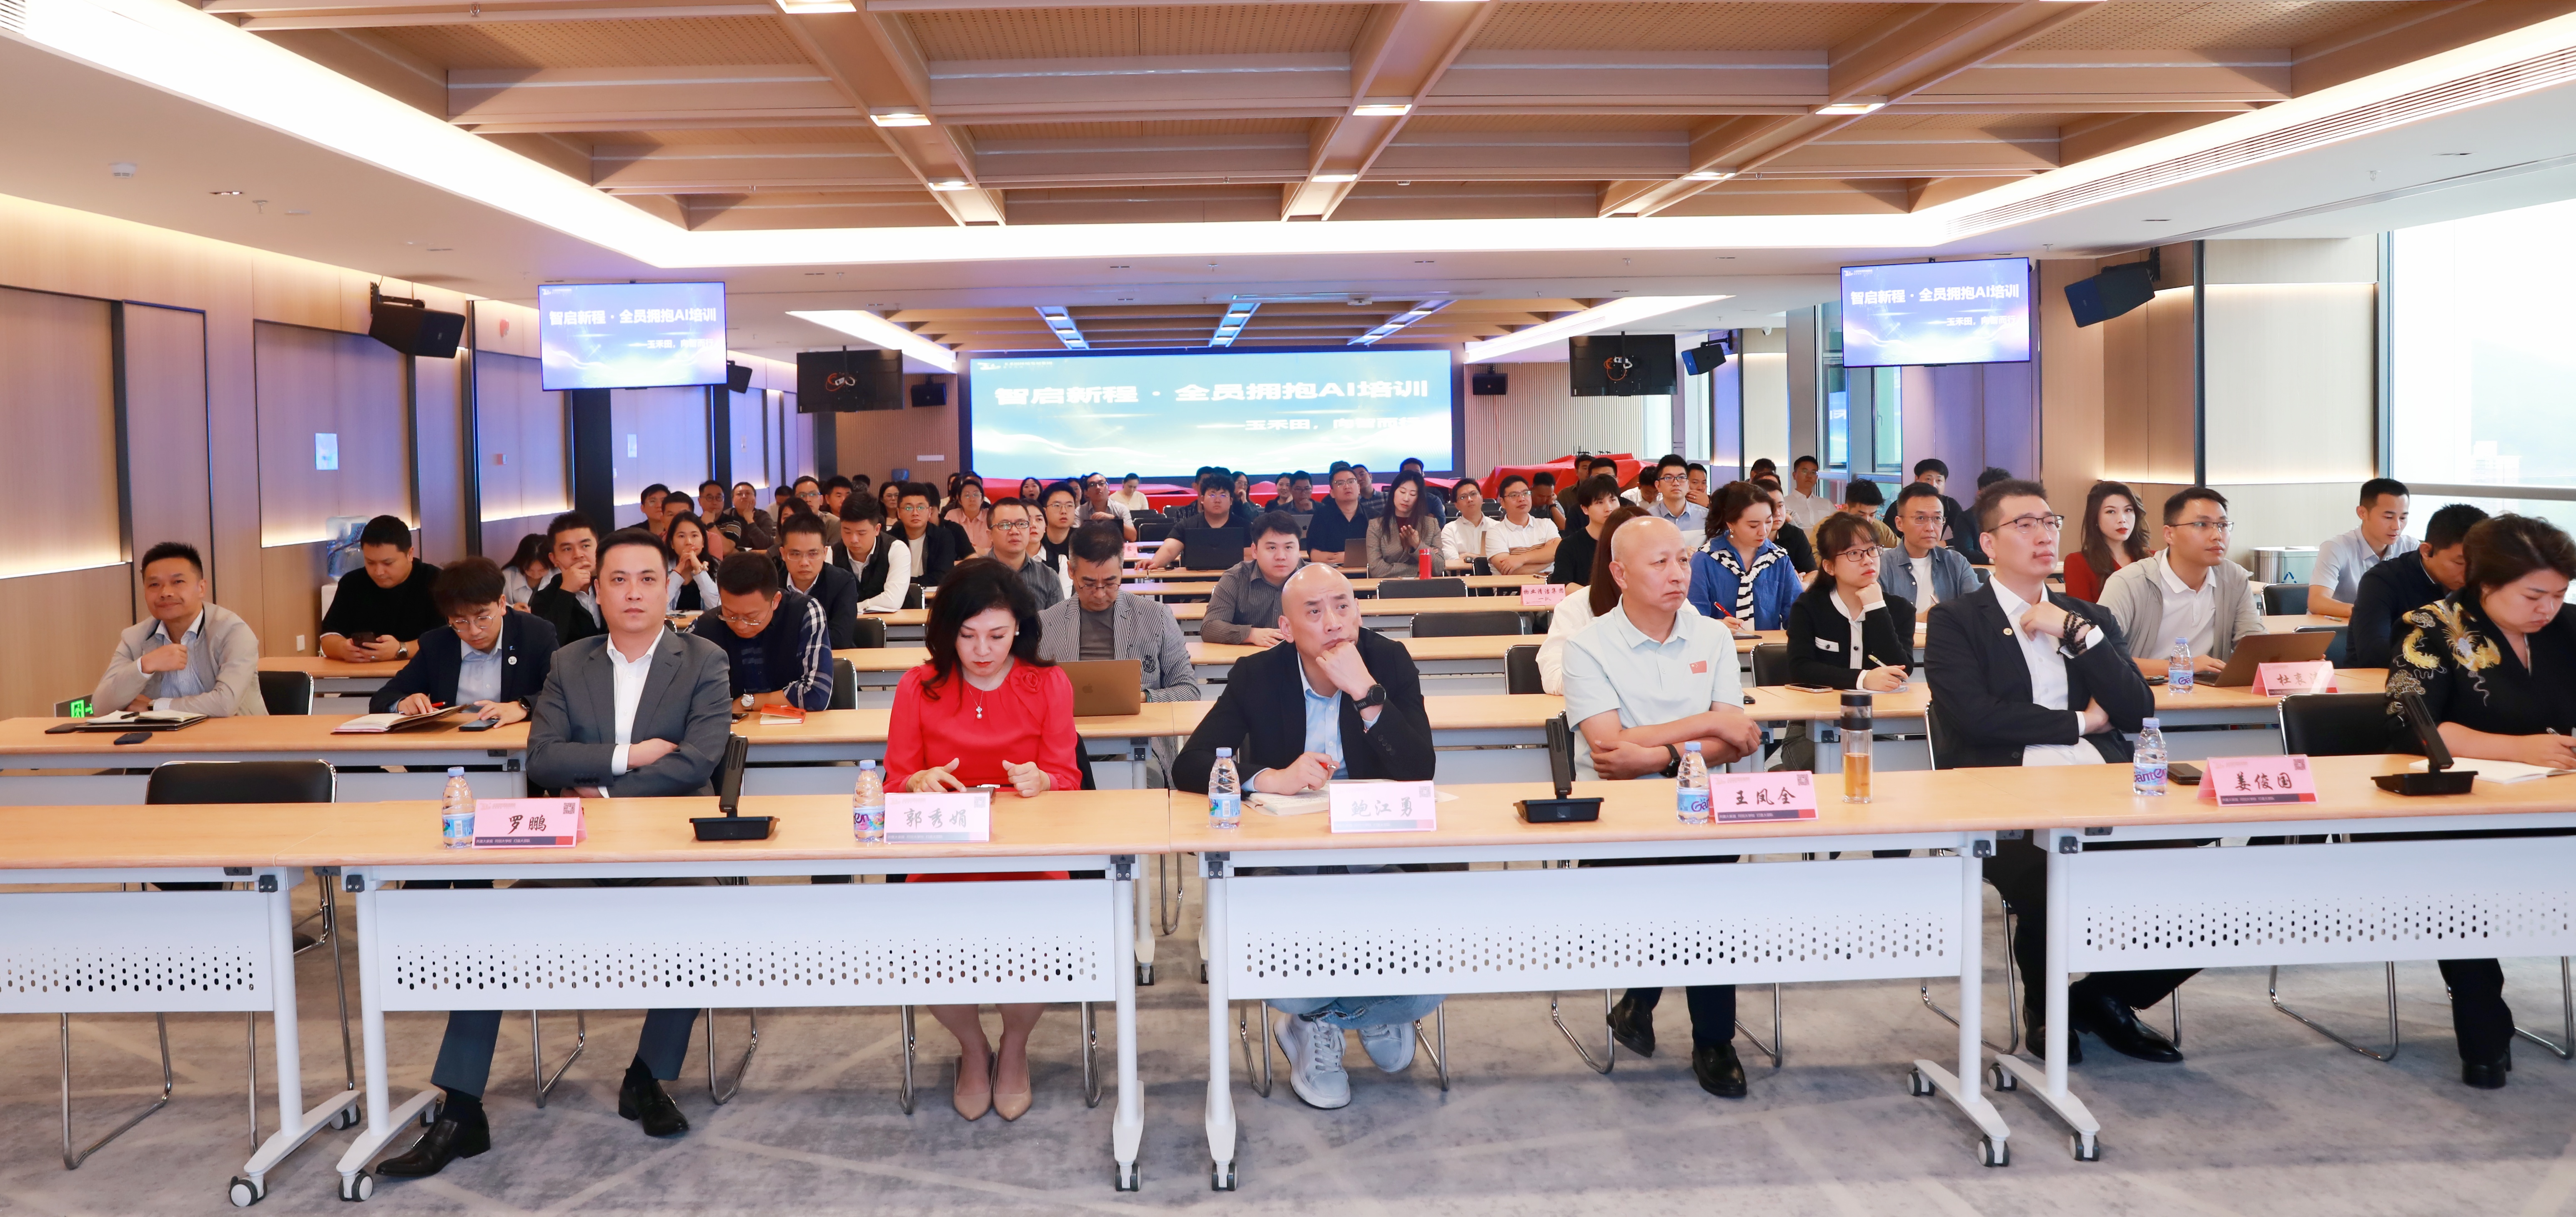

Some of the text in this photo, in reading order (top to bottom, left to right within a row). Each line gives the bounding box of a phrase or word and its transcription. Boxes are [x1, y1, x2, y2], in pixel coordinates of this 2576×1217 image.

[2235, 771, 2292, 791] 姜俊国
[1736, 787, 1796, 805] 王凤全
[1351, 796, 1413, 817] 鲍江勇
[507, 814, 547, 834] 罗鹏
[904, 807, 967, 829] 郭秀娟
